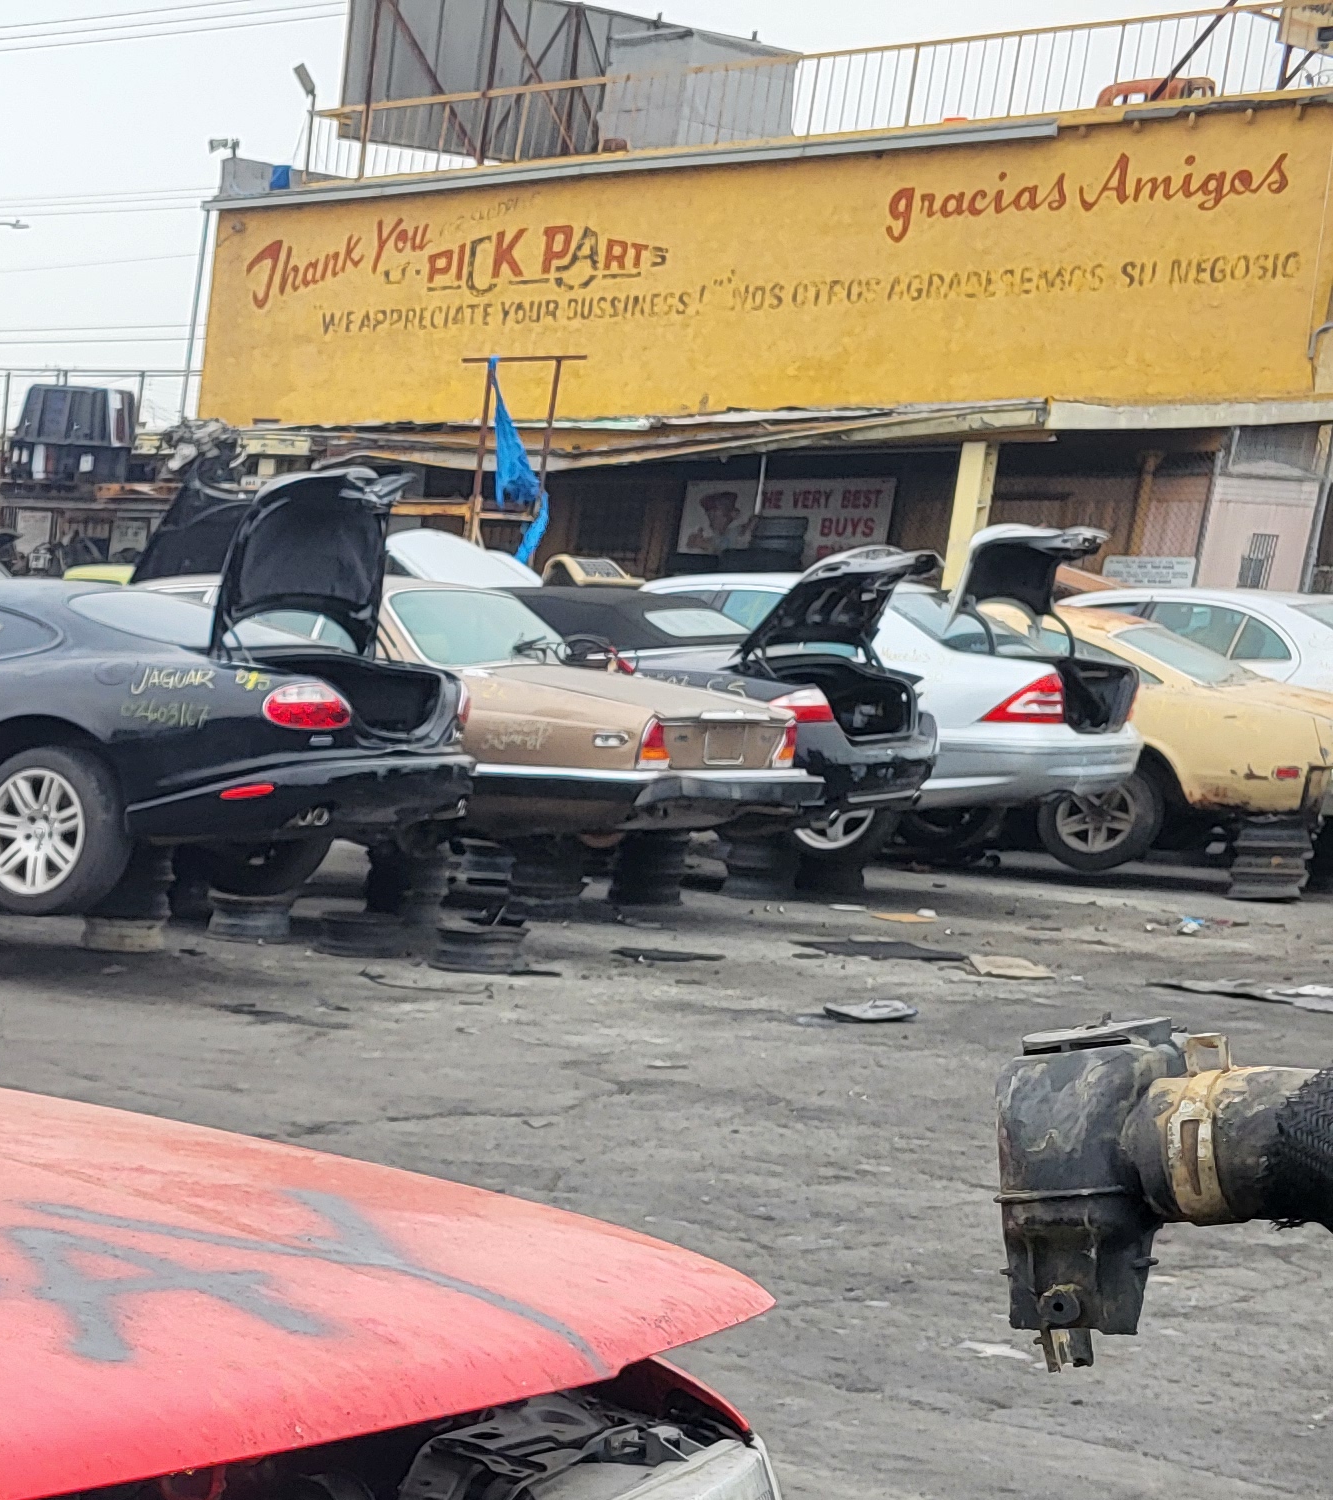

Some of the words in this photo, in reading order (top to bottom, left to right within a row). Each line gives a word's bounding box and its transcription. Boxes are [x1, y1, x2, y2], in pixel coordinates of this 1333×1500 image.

[885, 171, 1069, 243] gracias
[1077, 152, 1290, 212] Amigos
[245, 238, 366, 310] Thank
[370, 216, 433, 275] You
[1120, 259, 1158, 288] SU
[1167, 251, 1301, 286] NEGOSIO
[500, 299, 560, 327] YOUR
[762, 489, 784, 510] HE
[792, 489, 833, 510] VERY
[840, 488, 884, 510] BEST
[819, 516, 876, 538] BUYS
[130, 665, 217, 695] JAGUAR
